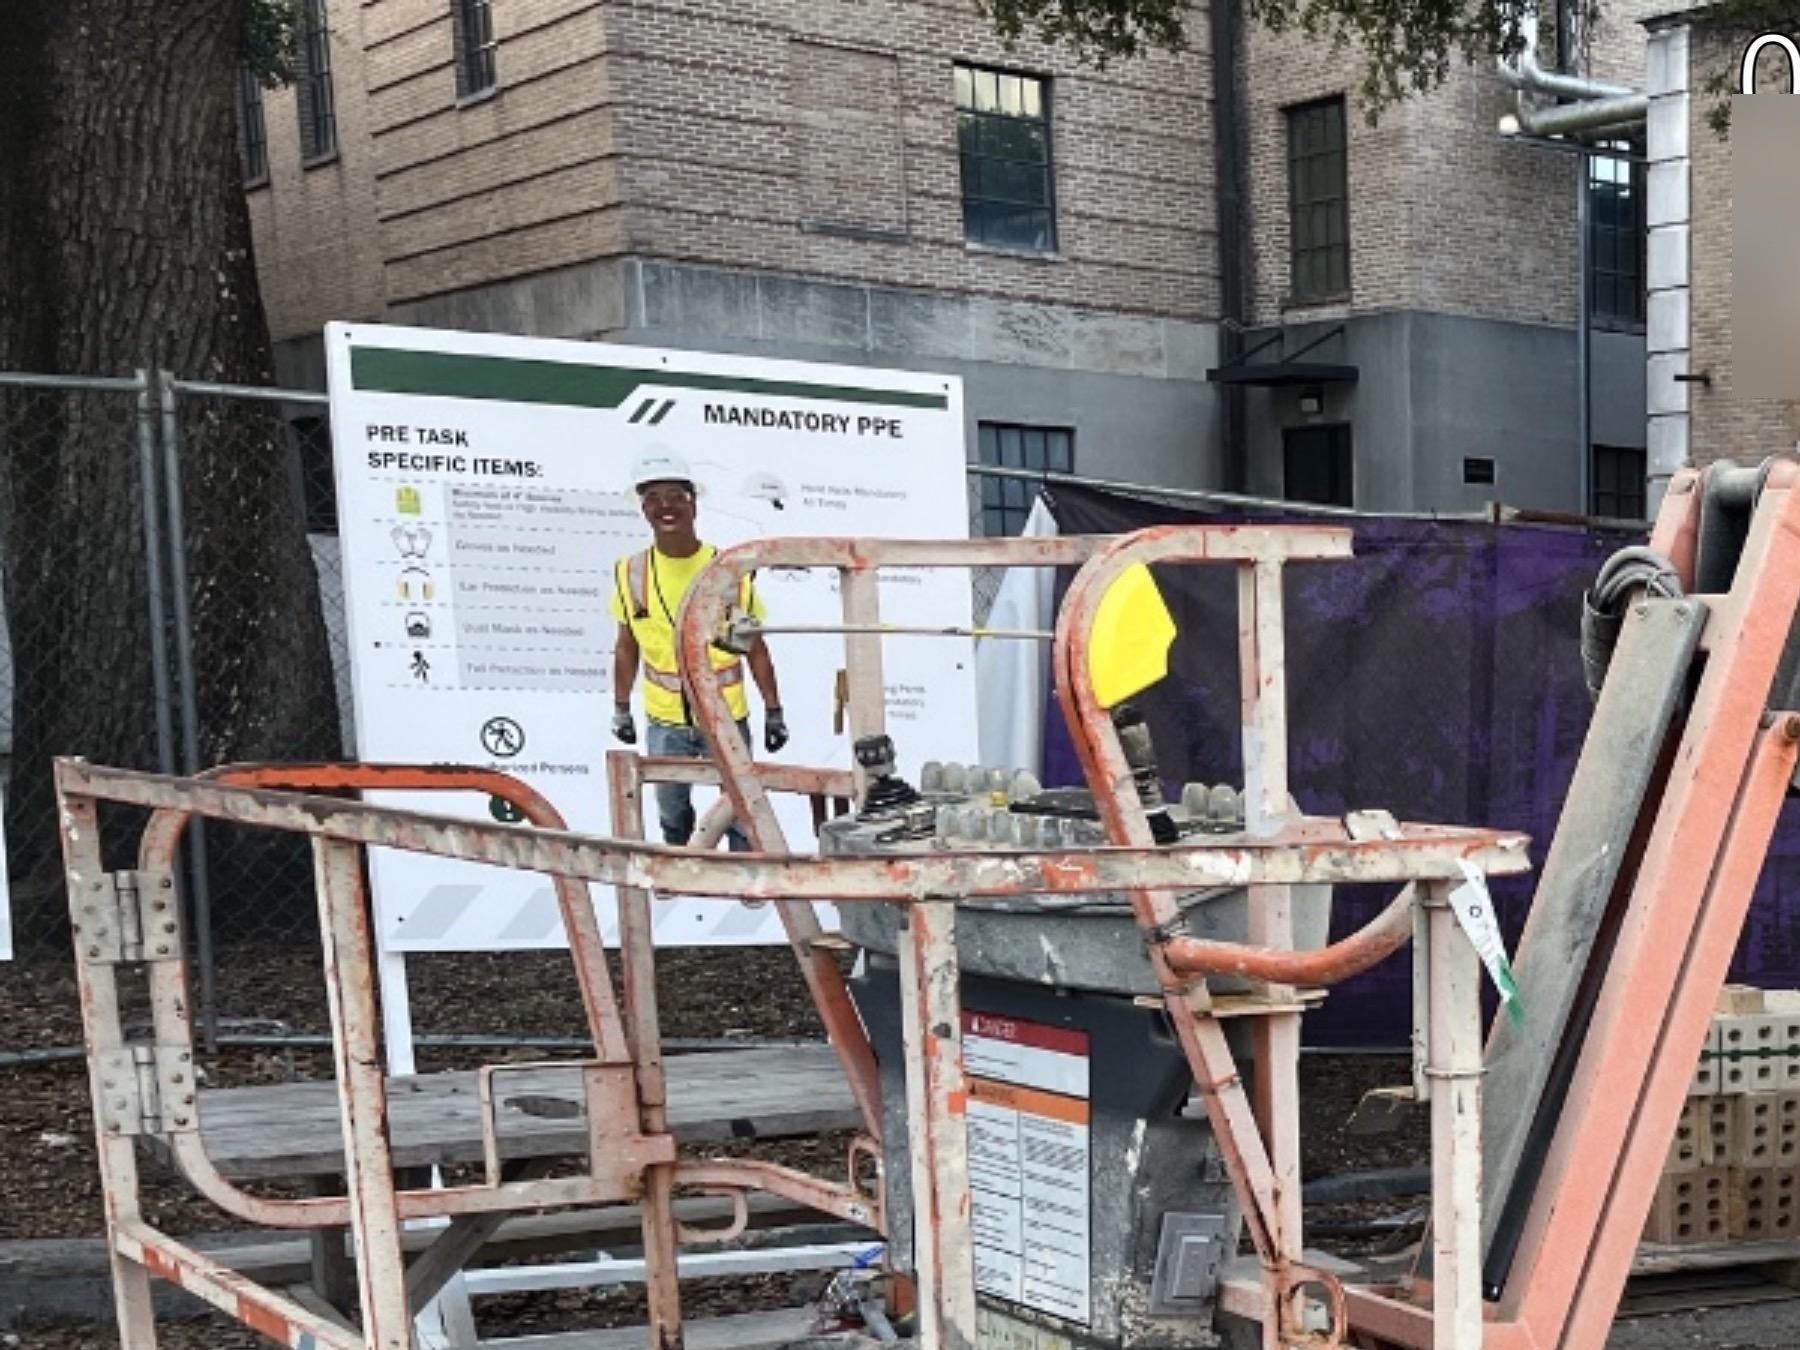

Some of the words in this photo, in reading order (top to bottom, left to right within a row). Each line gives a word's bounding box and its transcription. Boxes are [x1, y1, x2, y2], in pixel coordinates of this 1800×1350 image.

[703, 404, 850, 433] MANDATORY
[857, 416, 903, 438] PPE
[366, 425, 409, 443] PRE
[416, 428, 469, 447] TASK
[368, 452, 466, 473] SPECIFIC
[473, 458, 543, 477] ITEMS:
